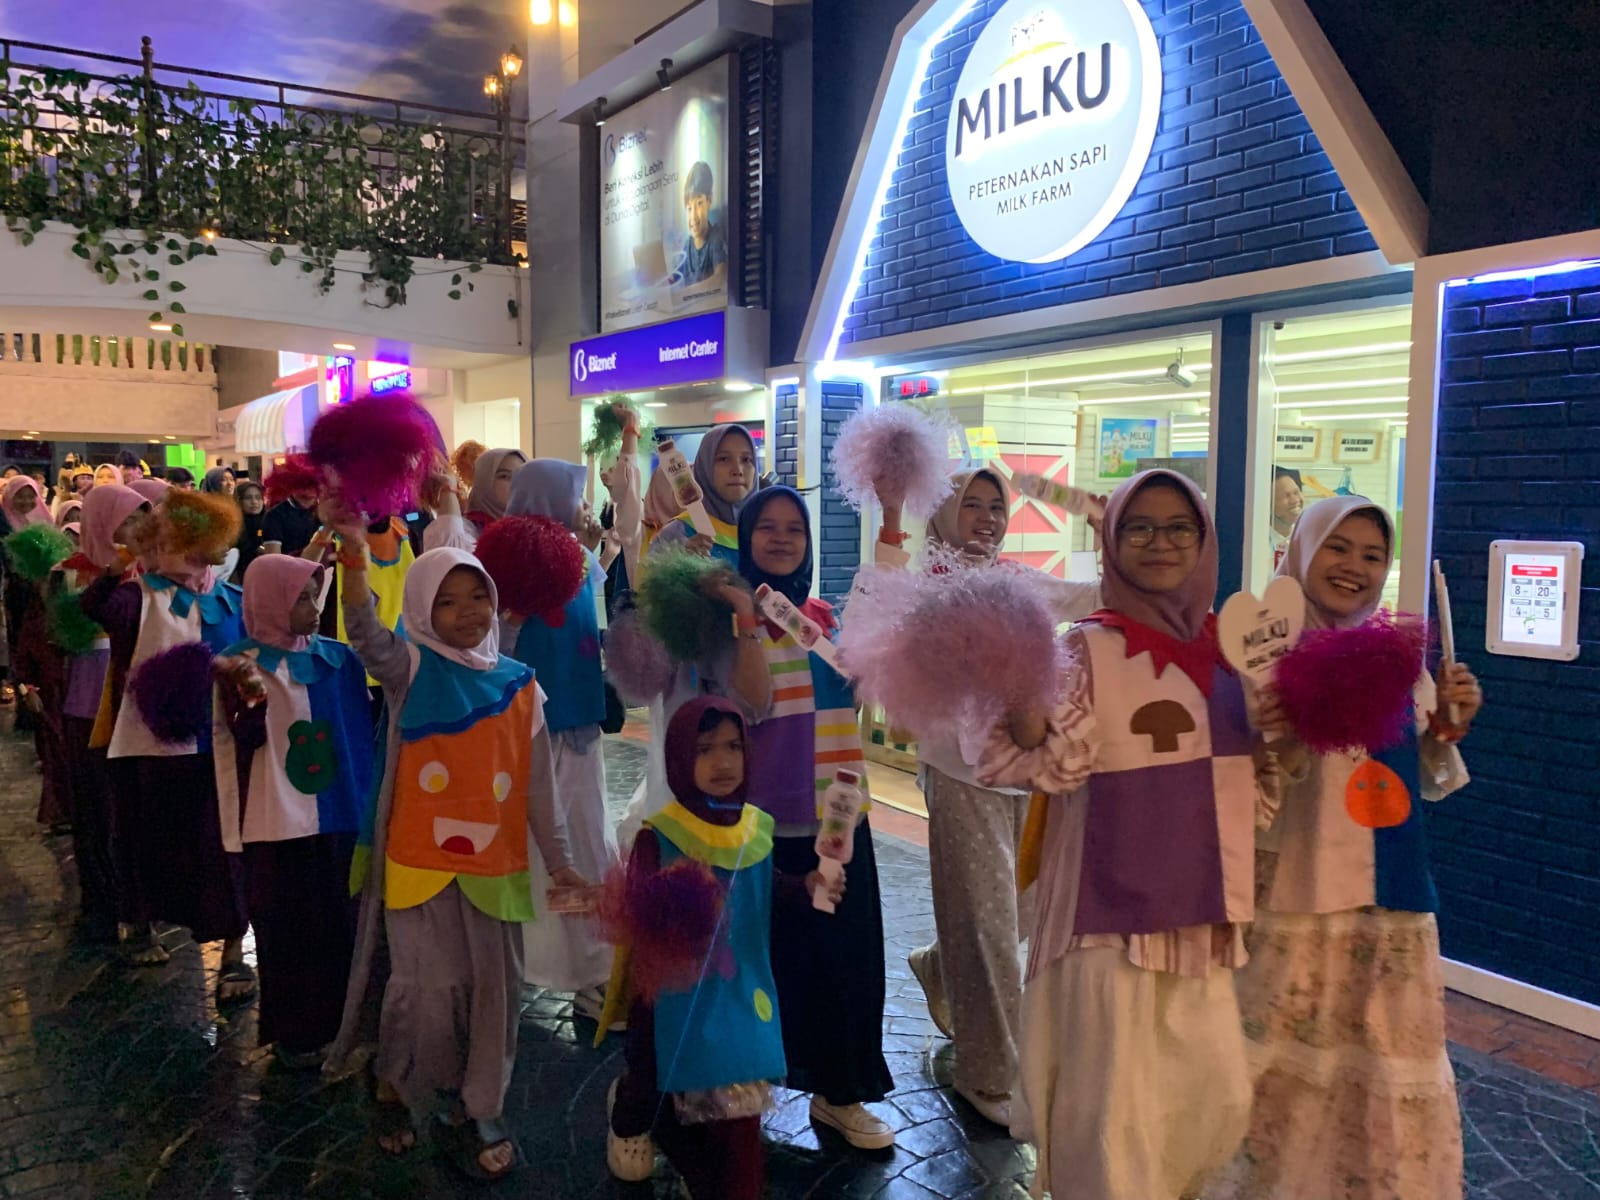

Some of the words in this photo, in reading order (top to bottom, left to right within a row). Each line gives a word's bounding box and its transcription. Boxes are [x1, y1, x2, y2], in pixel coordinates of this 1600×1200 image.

[955, 42, 1111, 158] MILKU
[619, 128, 647, 152] Biznet
[969, 156, 1064, 200] PETERNAKAN
[1069, 144, 1108, 170] SAPI
[996, 194, 1027, 216] MILK
[1031, 182, 1072, 206] FARM
[659, 344, 689, 362] Internet
[690, 339, 718, 357] Center
[588, 354, 616, 373] Biznet
[1537, 587, 1550, 597] 20
